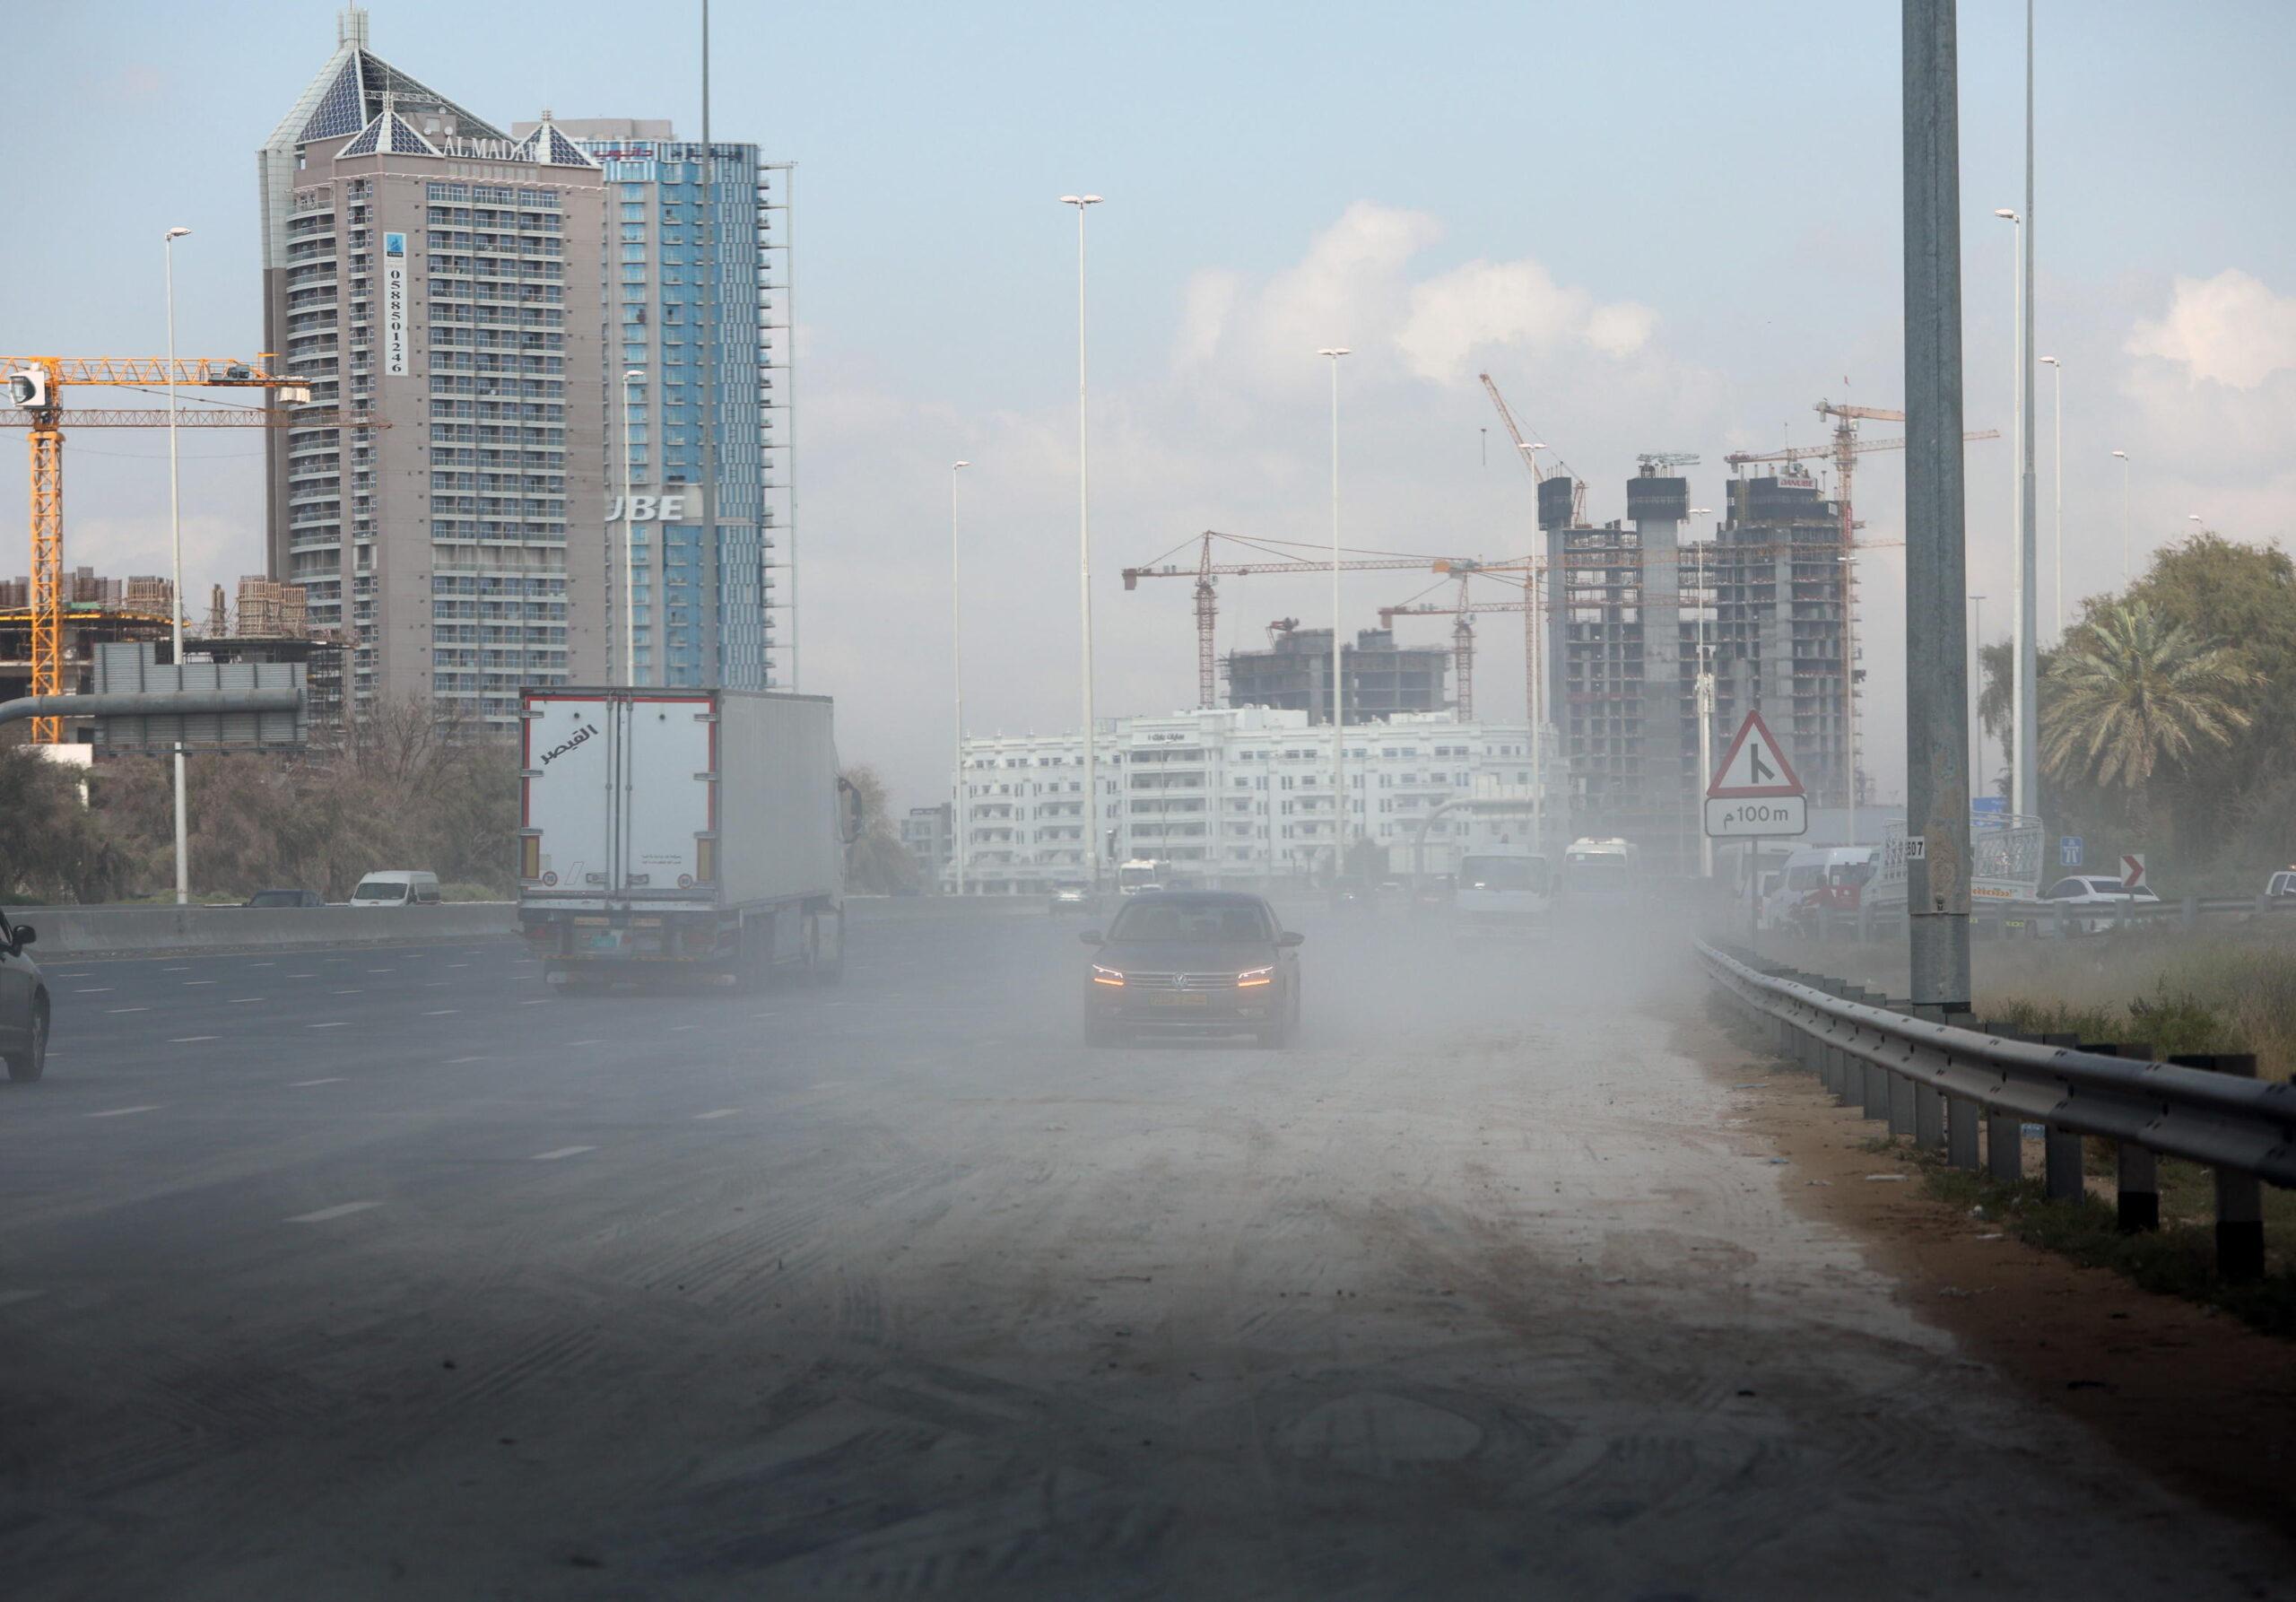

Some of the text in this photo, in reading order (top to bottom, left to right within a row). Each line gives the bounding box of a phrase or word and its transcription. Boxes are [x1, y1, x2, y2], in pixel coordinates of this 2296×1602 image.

[444, 135, 539, 162] AL MADAR
[390, 270, 402, 372] 0588501246
[540, 724, 598, 765] القيصر
[1737, 805, 1770, 822] 100
[1773, 809, 1788, 821] m
